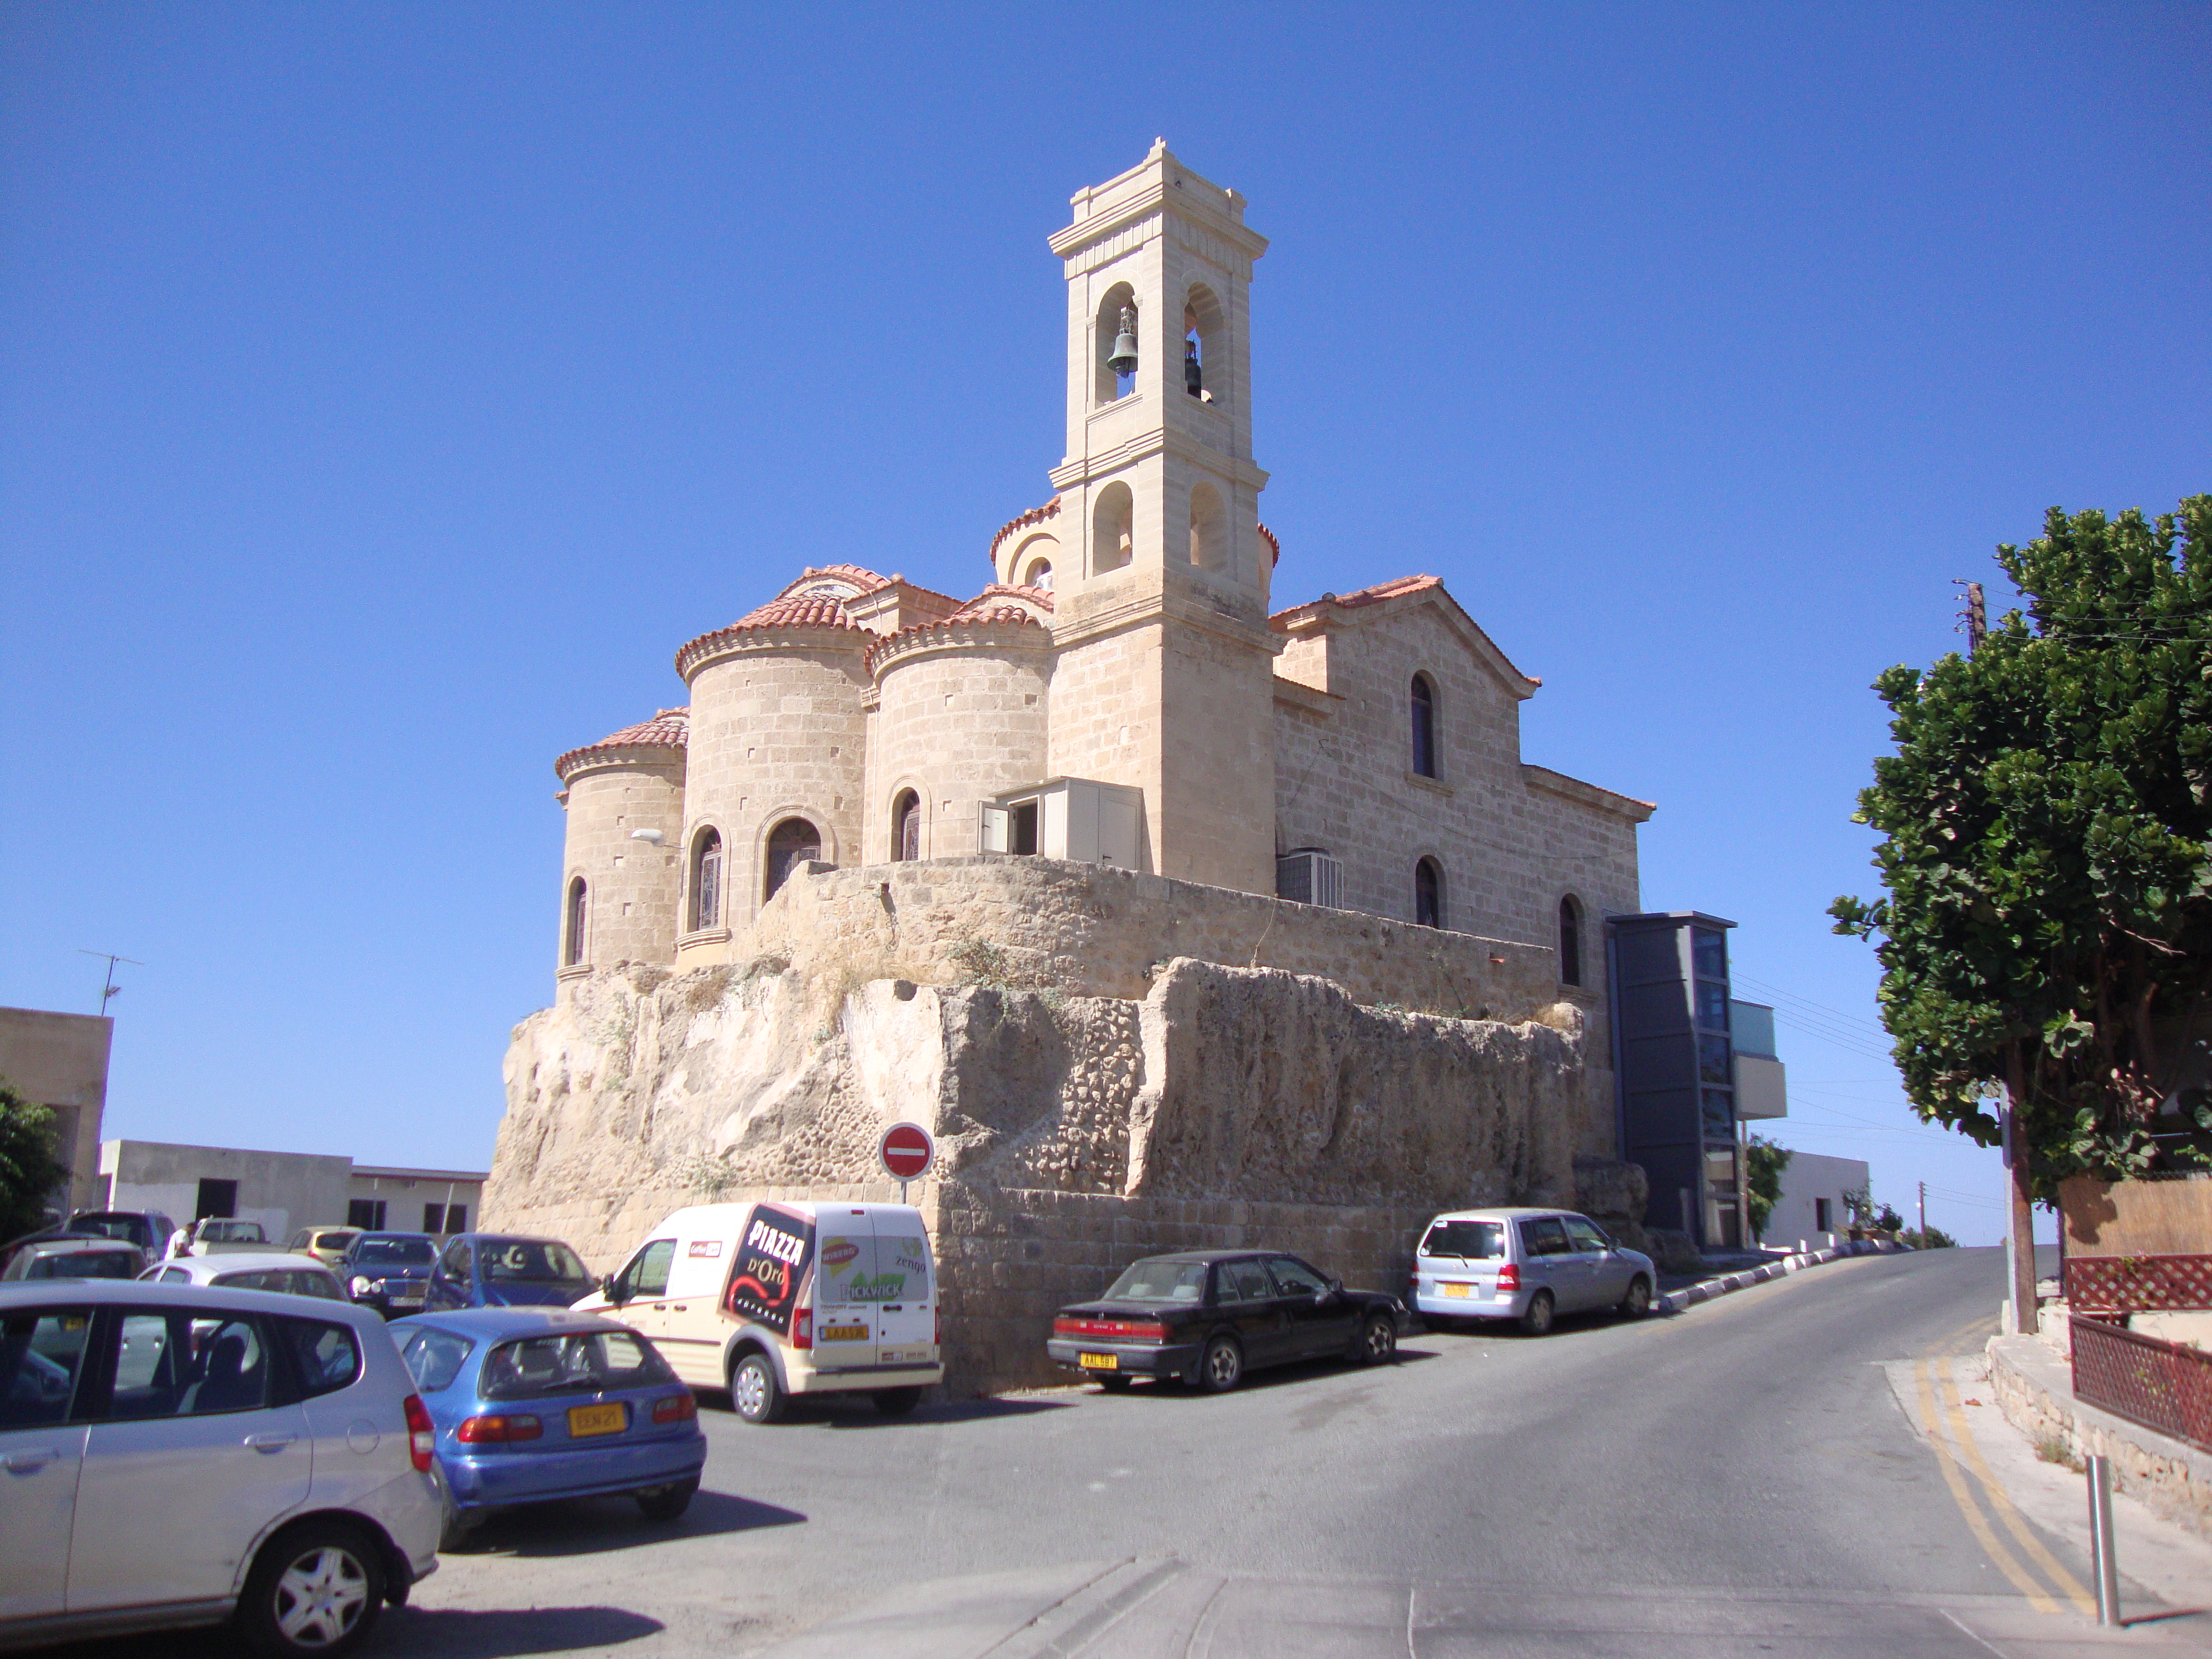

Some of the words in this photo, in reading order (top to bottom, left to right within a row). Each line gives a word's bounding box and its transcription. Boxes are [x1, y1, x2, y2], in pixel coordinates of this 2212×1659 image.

[748, 1219, 806, 1266] PIAZZA
[747, 1257, 784, 1286] D'Oro
[895, 1256, 926, 1275] zengo
[840, 1284, 904, 1301] PICKWICK
